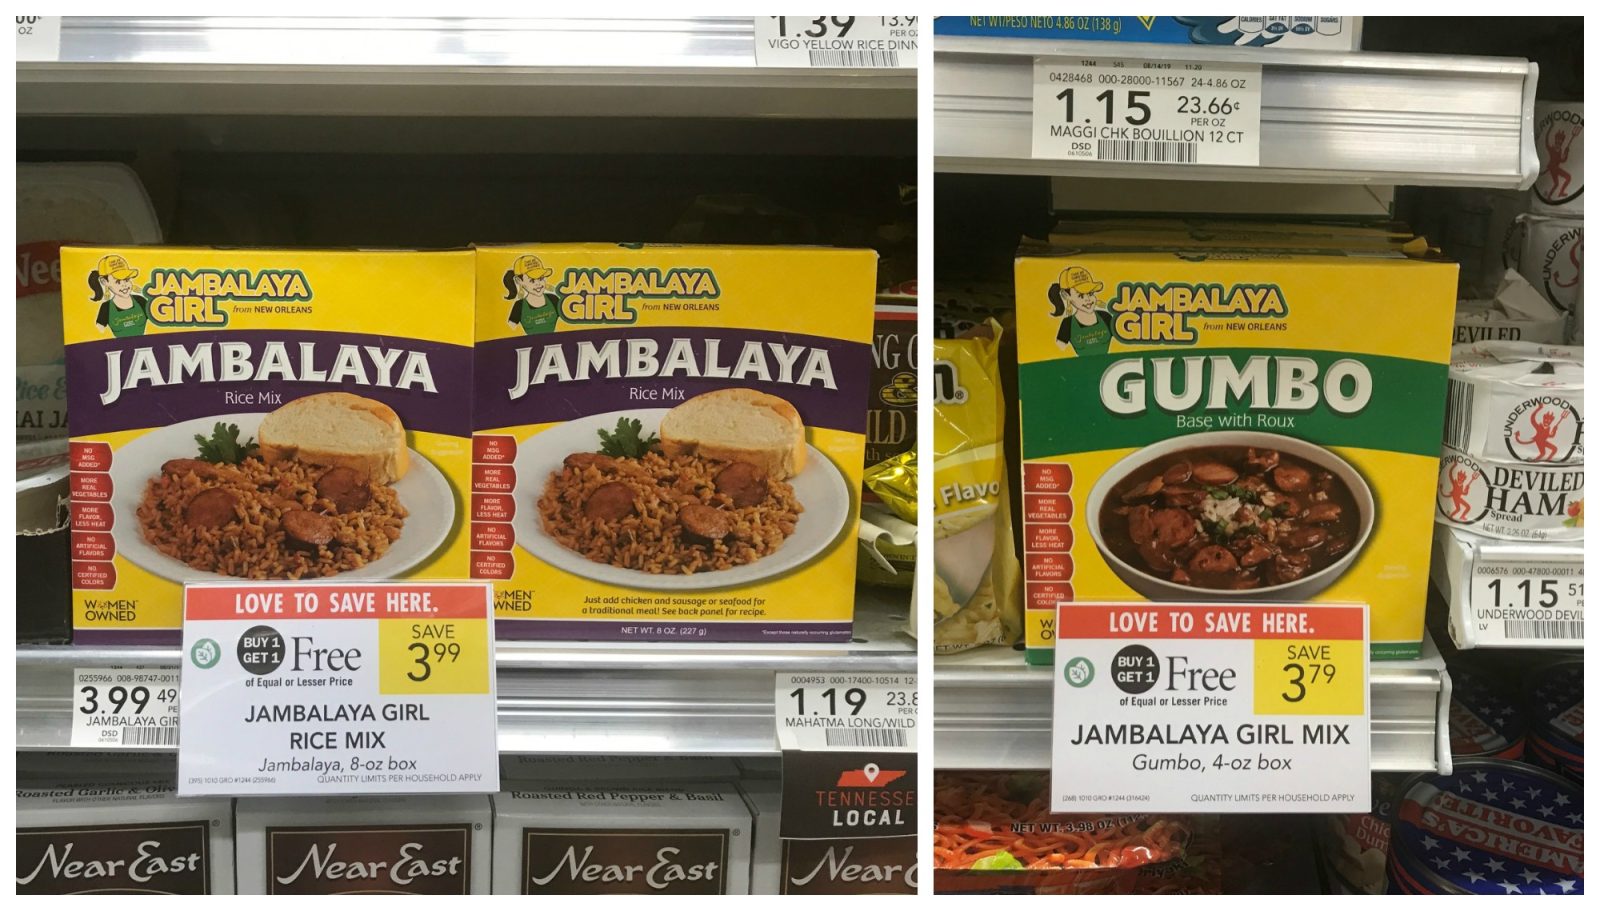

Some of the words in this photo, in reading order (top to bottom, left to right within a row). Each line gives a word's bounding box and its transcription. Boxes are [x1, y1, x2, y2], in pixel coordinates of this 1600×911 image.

[770, 16, 856, 38] 1.39
[1030, 16, 1053, 29] NETO
[1056, 17, 1075, 30] 4.86
[1078, 18, 1089, 30] OZ
[1091, 17, 1111, 32] (138
[768, 39, 799, 50] VIGO
[803, 39, 853, 50] YELLOW
[857, 40, 884, 50] RICE
[1049, 72, 1093, 84] 0428468
[1098, 74, 1185, 87] 000-28000-11567
[1191, 77, 1228, 89] 24-4.86
[1230, 79, 1247, 89] OZ
[1056, 88, 1152, 126] 1.15
[1191, 117, 1209, 127] PER
[1211, 118, 1226, 127] OZ
[1050, 125, 1097, 139] MAGGI
[1100, 126, 1129, 139] CHK
[1133, 128, 1205, 142] BOUILLION
[1209, 130, 1223, 143] 12
[1226, 131, 1244, 143] CT
[1071, 142, 1092, 150] DSD
[146, 271, 309, 298] JAMBALAYA
[559, 271, 717, 296] JAMBALAYA
[561, 294, 634, 320] GIRL
[641, 303, 661, 312] from
[682, 303, 720, 312] ORLEANS
[1112, 286, 1284, 314] JAMBALAYA
[149, 295, 224, 323] GIRL
[232, 304, 253, 314] from
[254, 305, 273, 314] NEW
[274, 305, 313, 314] ORLEANS
[1115, 312, 1194, 341] GIRL
[1203, 322, 1224, 332] from
[1226, 323, 1245, 331] NEW
[1247, 323, 1288, 331] ORLEANS
[100, 340, 439, 406] JAMBALAYA
[508, 337, 839, 400] JAMBALAYA
[1099, 355, 1373, 415] GUMBO
[224, 391, 254, 405] Rice
[257, 391, 282, 405] Mix
[629, 387, 658, 401] Rice
[662, 387, 685, 401] Mix
[1176, 414, 1213, 428] Base
[1218, 413, 1252, 428] with
[1257, 414, 1295, 428] Roux
[1503, 396, 1571, 438] UNDERWOOD
[1493, 466, 1584, 492] DEVILED
[1485, 485, 1568, 516] HAM
[1490, 510, 1523, 523] Spread
[1477, 566, 1509, 575] 0006576
[1512, 567, 1574, 576] 000-47800-00011
[583, 595, 601, 604] Just
[603, 595, 619, 604] add
[621, 596, 653, 605] chicken
[654, 596, 671, 605] and
[672, 598, 707, 607] sausage
[719, 597, 752, 606] seafood
[1488, 579, 1559, 609] 1.15
[235, 593, 284, 614] LOVE
[294, 592, 319, 614] TO
[329, 592, 376, 613] SAVE
[386, 592, 439, 613] HERE.
[85, 610, 137, 622] OWNED
[589, 606, 634, 614] traditional
[636, 606, 660, 615] meal!
[661, 607, 677, 615] See
[678, 607, 699, 615] back
[700, 608, 724, 617] panel
[739, 608, 767, 617] recipe.
[1477, 609, 1553, 621] UNDERWOOD
[621, 626, 639, 634] NET
[680, 627, 697, 636] (227
[1109, 612, 1158, 633] LOVE
[1169, 612, 1194, 633] TO
[1204, 612, 1251, 633] SAVE
[1262, 612, 1315, 634] HERE.
[1479, 623, 1489, 631] LV
[412, 624, 455, 640] SAVE
[243, 637, 268, 648] BUY
[271, 637, 280, 648] 1
[243, 652, 269, 664] GET
[271, 652, 280, 664] 1
[291, 636, 362, 672] Free
[1287, 645, 1331, 660] SAVE
[1117, 656, 1143, 667] BUY
[1146, 656, 1155, 667] 1
[79, 674, 113, 683] 0255966
[830, 677, 899, 685] 000-17400-10514
[1117, 671, 1143, 683] GET
[1145, 671, 1155, 683] 1
[1165, 656, 1237, 692] Free
[245, 677, 254, 688] of
[257, 677, 282, 689] Equal
[285, 679, 294, 687] or
[297, 677, 326, 687] Lesser
[329, 676, 353, 686] Price
[79, 686, 150, 715] 3.99
[156, 688, 177, 703] 49
[790, 687, 867, 716] 1.19
[1119, 697, 1128, 707] of
[1131, 697, 1157, 708] Equal
[1159, 699, 1168, 707] or
[1171, 697, 1201, 707] Lesser
[1203, 696, 1228, 706] Price
[244, 704, 376, 723] JAMBALAYA
[382, 703, 430, 722] GIRL
[898, 707, 913, 715] PER
[86, 716, 157, 727] JAMBALAYA
[785, 717, 845, 728] MAHATMA
[848, 717, 916, 729] LONG/WILD
[101, 729, 119, 737] DSD
[290, 732, 337, 750] RICE
[345, 731, 386, 749] MIX
[1070, 723, 1229, 745] JAMBALAYA
[1236, 723, 1294, 745] GIRL
[1302, 724, 1351, 745] MIX
[258, 756, 345, 775] Jambalaya,
[350, 756, 383, 771] 8-oz
[388, 755, 417, 771] box
[1132, 753, 1206, 773] Gumbo,
[1212, 753, 1252, 770] 4-oz
[1257, 752, 1292, 770] box
[317, 774, 360, 784] QUANTITY
[361, 774, 387, 783] LIMITS
[388, 774, 402, 782] PER
[405, 774, 457, 782] HOUSEHOLD
[458, 773, 483, 782] APPLY
[78, 787, 119, 797] Garlic
[511, 790, 572, 801] Roasted
[577, 791, 606, 801] Red
[610, 792, 665, 803] Pepper
[687, 792, 724, 802] Basil
[816, 791, 915, 807] TENNESSE
[1190, 794, 1233, 803] QUANTITY
[1234, 794, 1261, 802] LIMITS
[1262, 794, 1277, 802] PER
[1278, 794, 1330, 802] HOUSEHOLD
[1331, 794, 1355, 802] APPLY
[833, 810, 905, 827] LOCAL
[1010, 822, 1036, 834] NET
[1066, 822, 1096, 834] 3.98
[16, 842, 125, 885] Near
[128, 840, 200, 882] East
[276, 842, 387, 885] Near
[389, 842, 463, 885] East
[532, 845, 644, 886] Near
[646, 846, 719, 889] East
[791, 845, 903, 886] Near
